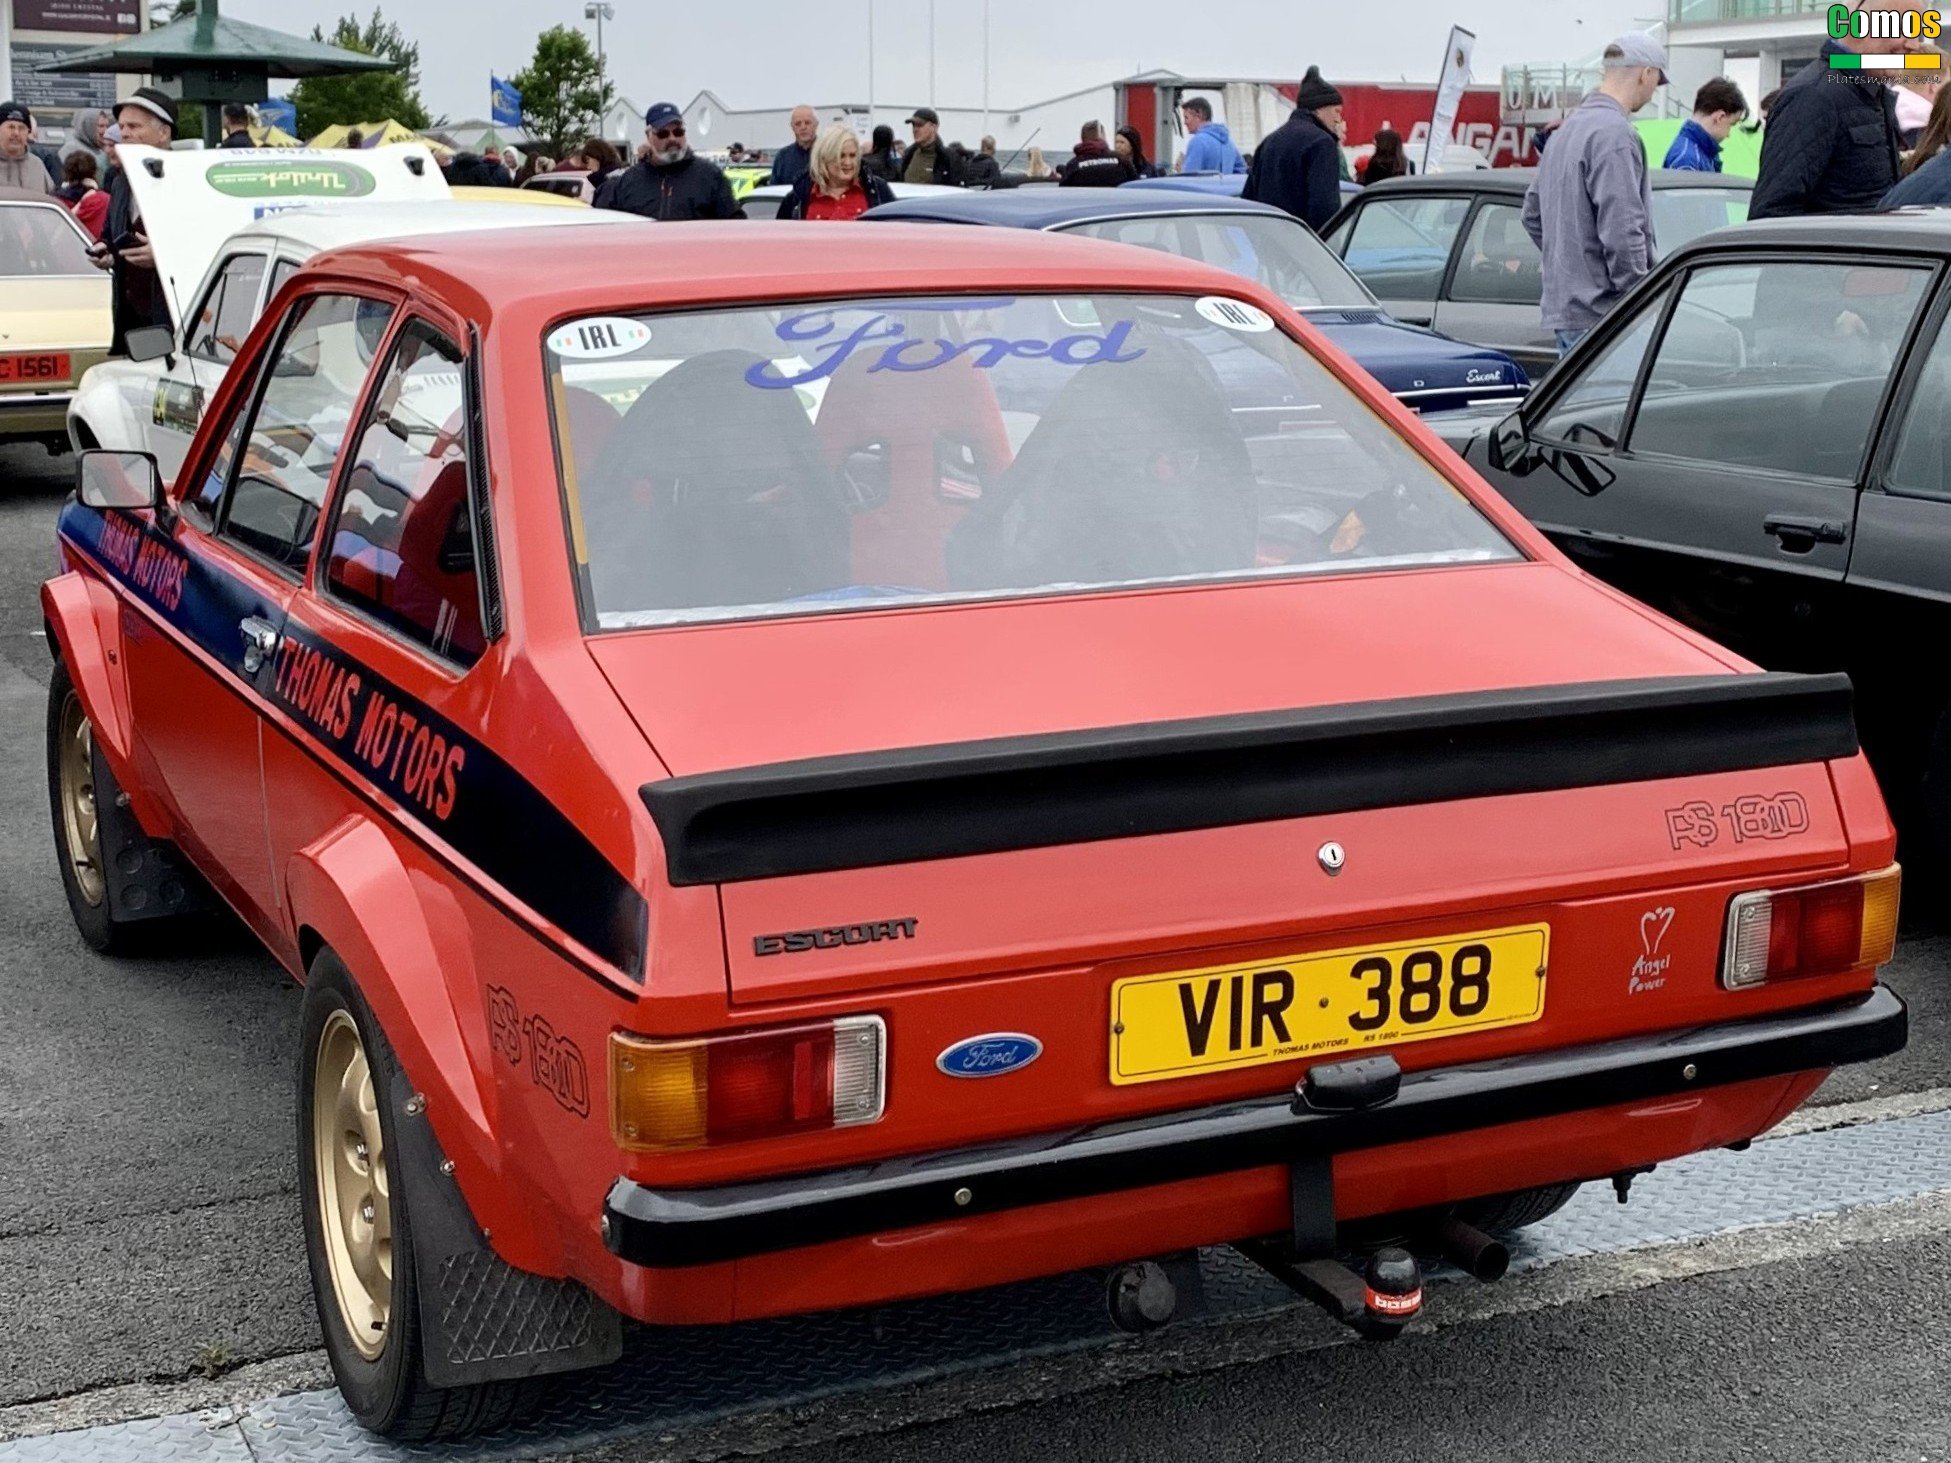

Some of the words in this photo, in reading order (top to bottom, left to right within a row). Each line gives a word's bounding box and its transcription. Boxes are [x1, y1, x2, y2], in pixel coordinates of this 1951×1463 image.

[1212, 302, 1257, 326] IRL
[578, 323, 623, 351] IRL
[745, 295, 1148, 390] Ford
[16, 355, 59, 378] 1561
[1466, 368, 1501, 383] Escort
[132, 534, 189, 612] MOTORS
[275, 635, 361, 740] THOMAS
[354, 690, 466, 821] MOTORS
[753, 916, 919, 957] ESCORT
[1631, 953, 1671, 977] Angel
[1628, 976, 1666, 995] Power
[1177, 969, 1295, 1058] VIR
[1347, 943, 1492, 1032] 388
[962, 1042, 1018, 1070] Ford
[1272, 1043, 1310, 1057] THOMAS
[1311, 1037, 1349, 1050] MOTORS
